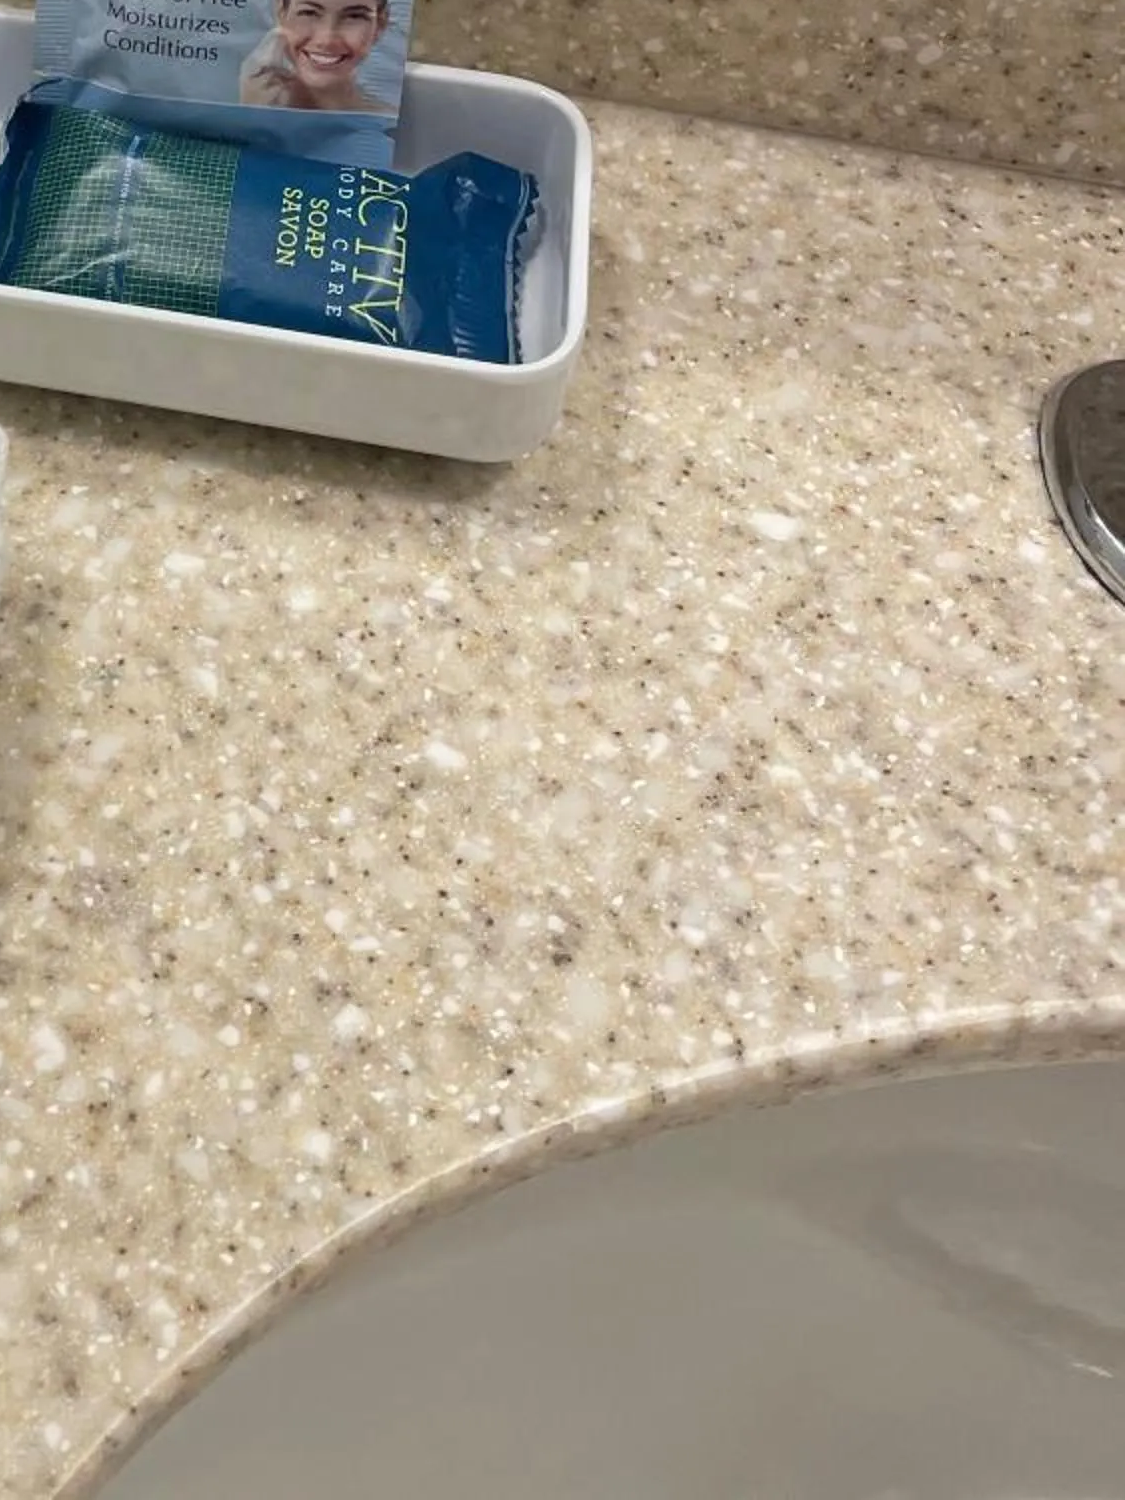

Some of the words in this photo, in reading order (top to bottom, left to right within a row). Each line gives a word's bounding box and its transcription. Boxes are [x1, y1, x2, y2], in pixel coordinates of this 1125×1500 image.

[103, 29, 219, 61] Conditions
[107, 0, 231, 35] Moisturizes
[336, 167, 356, 219] ODY
[275, 187, 304, 268] SAVON
[305, 197, 330, 260] SOAP
[348, 169, 411, 345] ACTIV
[326, 238, 349, 317] CARE
